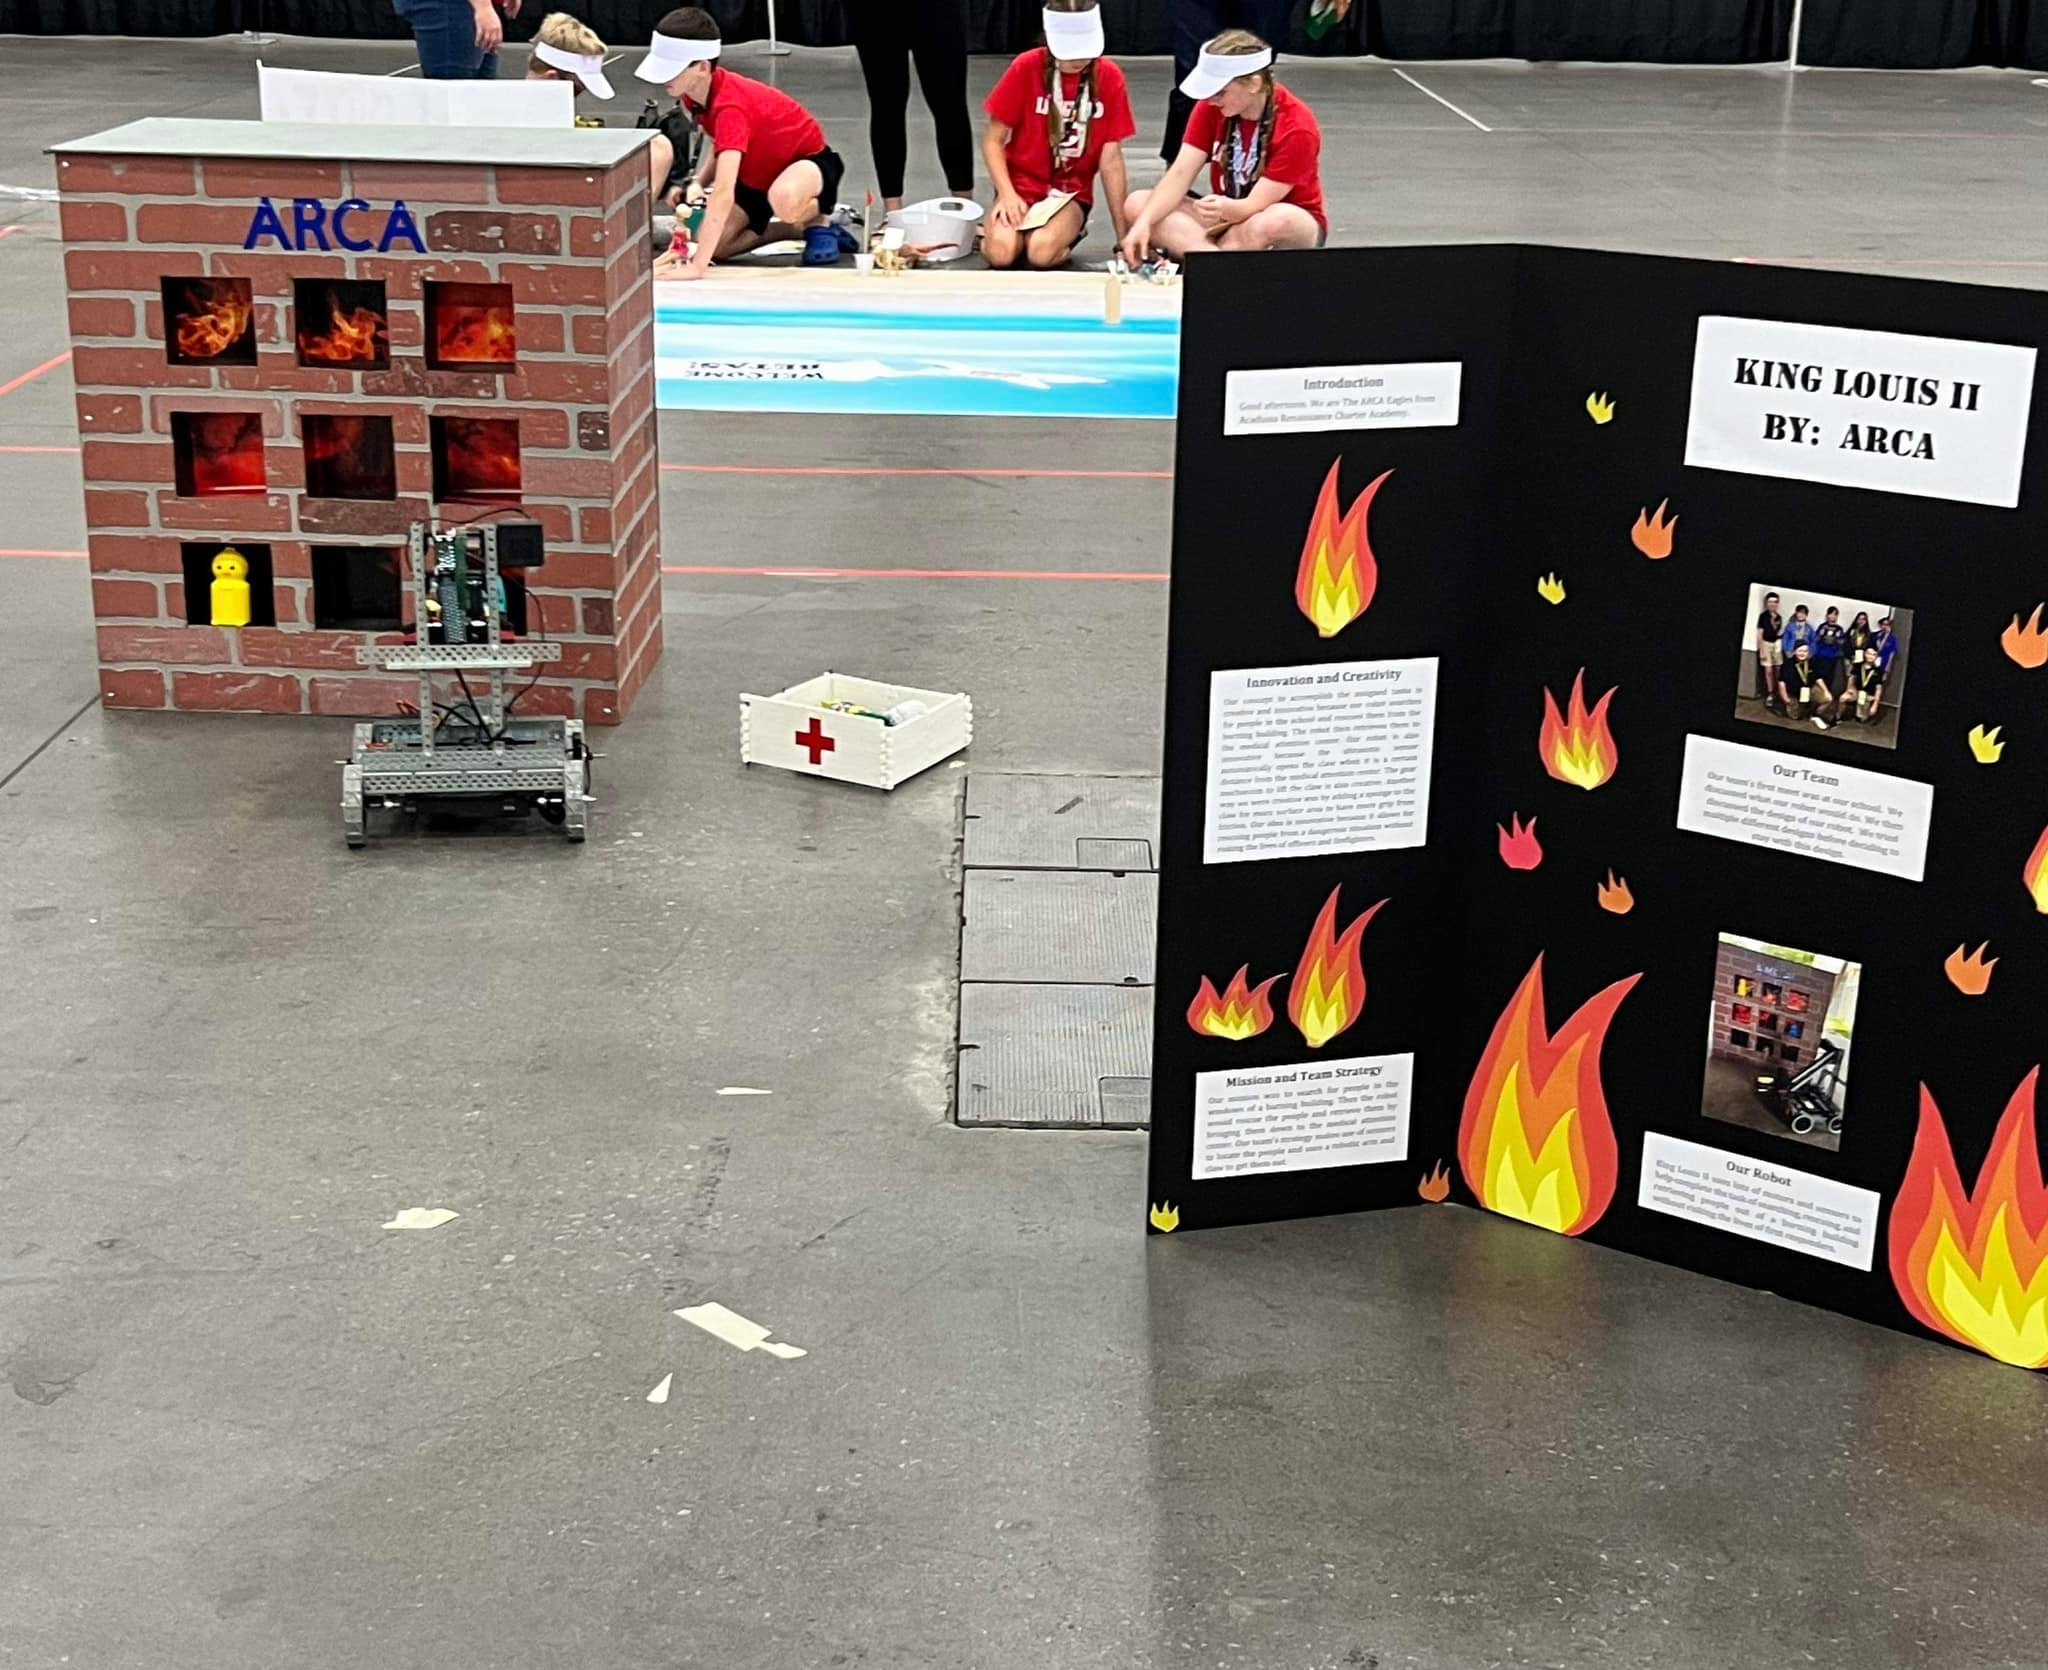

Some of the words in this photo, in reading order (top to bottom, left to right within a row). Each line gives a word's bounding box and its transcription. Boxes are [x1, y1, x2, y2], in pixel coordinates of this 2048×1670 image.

[243, 196, 428, 253] ARCA
[1303, 375, 1384, 389] Introduction
[1734, 357, 1823, 394] KING
[1833, 368, 1940, 406] LOUIS
[1950, 382, 1982, 411] II
[1762, 413, 1821, 446] BY:
[1839, 423, 1936, 460] ARCA
[1247, 673, 1313, 688] Innovation
[1317, 672, 1339, 683] and
[1342, 668, 1401, 684] Creativity
[1772, 762, 1797, 778] Our
[1802, 769, 1839, 787] Team
[1226, 1074, 1271, 1087] Mission
[1274, 1072, 1296, 1083] and
[1301, 1068, 1332, 1081] Team
[1335, 1064, 1382, 1079] Strategy
[1726, 1160, 1749, 1176] Our
[1753, 1167, 1791, 1187] Robot
